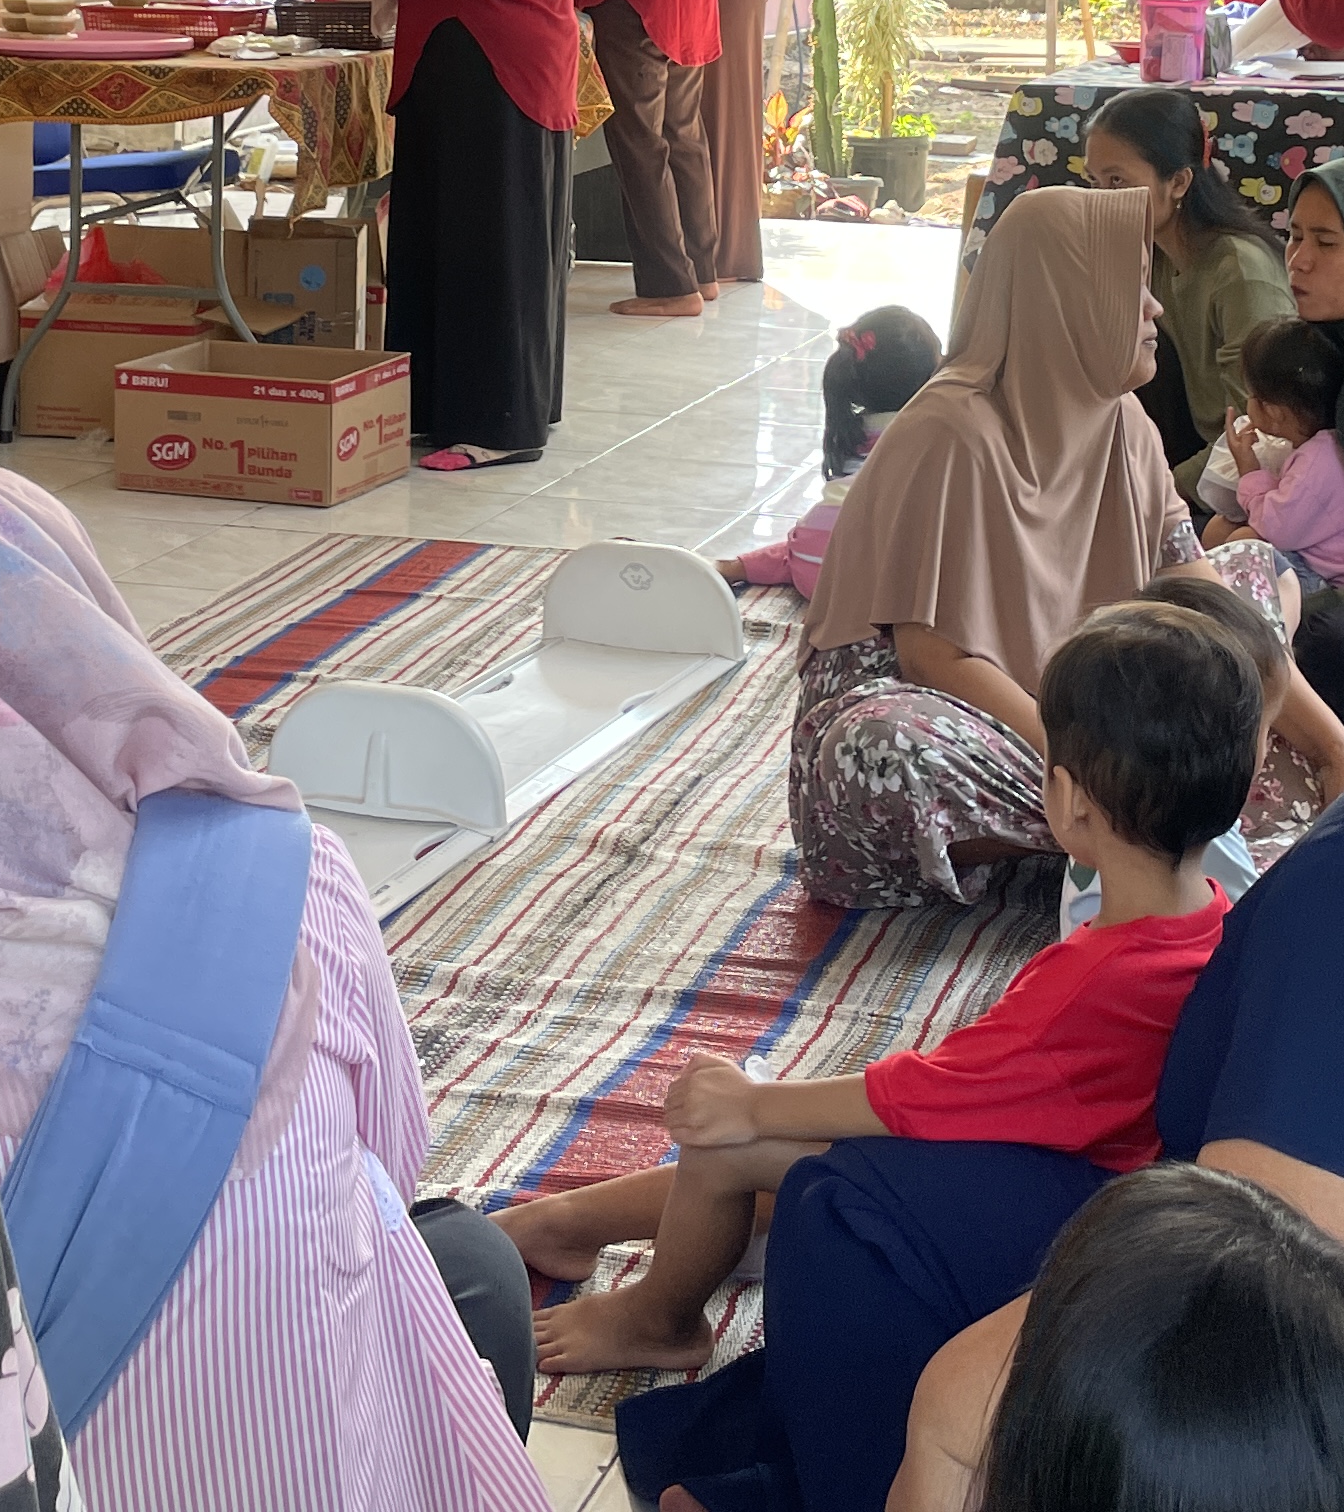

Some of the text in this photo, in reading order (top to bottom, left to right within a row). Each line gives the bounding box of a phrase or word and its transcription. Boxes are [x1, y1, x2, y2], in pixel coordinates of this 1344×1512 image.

[131, 375, 169, 388] BARU!
[252, 385, 325, 402] 21 dus x 400g
[151, 441, 190, 462] SGM
[201, 437, 298, 475] No. 1 Pilihan
[247, 464, 293, 479] Bunda
